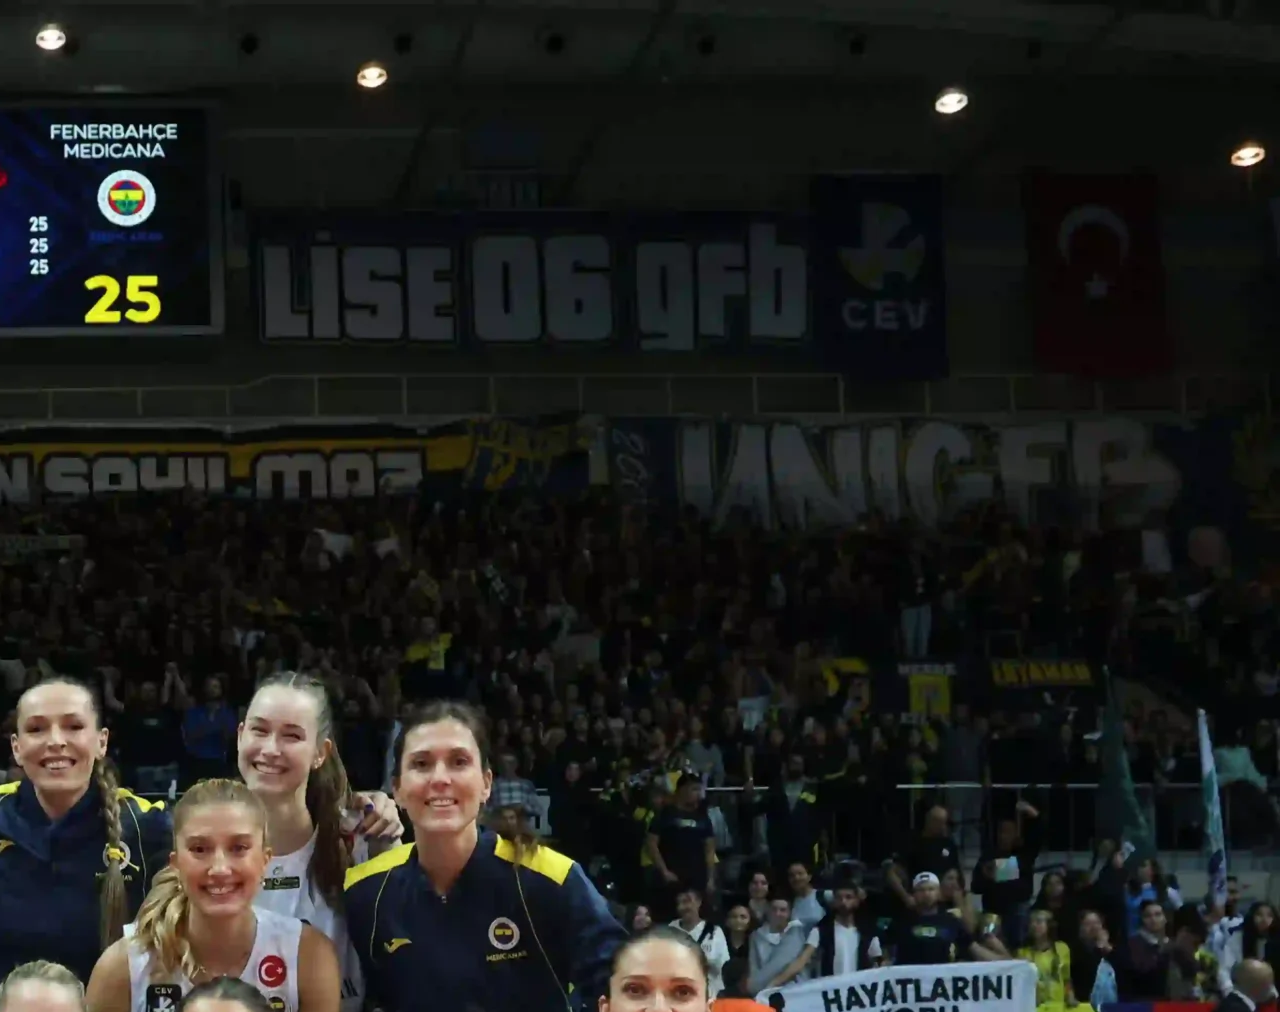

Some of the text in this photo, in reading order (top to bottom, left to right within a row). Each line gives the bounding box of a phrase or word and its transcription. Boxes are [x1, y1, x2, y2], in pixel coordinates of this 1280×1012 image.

[50, 123, 178, 141] FENERBAHÇE
[63, 142, 166, 159] MEDICANA
[29, 216, 49, 233] 25
[29, 237, 49, 254] 25
[30, 259, 49, 275] 25
[472, 235, 613, 341] 06
[83, 275, 161, 324] 25
[841, 300, 928, 329] CEV
[154, 987, 173, 995] CEV
